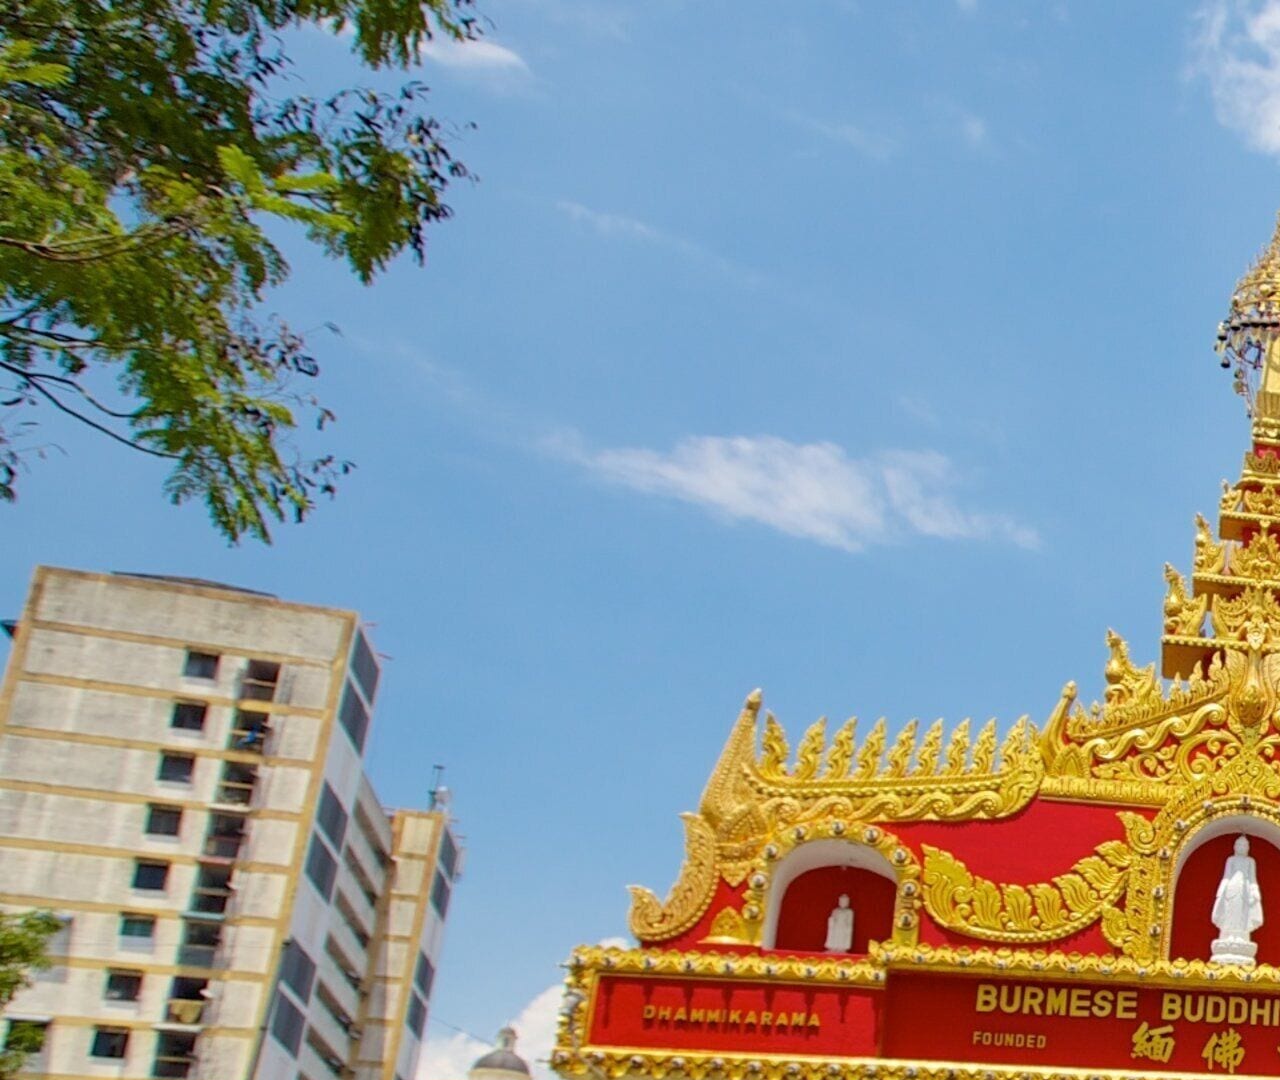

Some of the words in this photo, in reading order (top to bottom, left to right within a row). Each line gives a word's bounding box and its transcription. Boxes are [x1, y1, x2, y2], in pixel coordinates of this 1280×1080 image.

[975, 984, 1138, 1019] BURMESE
[642, 1005, 821, 1027] DHAMMIKARAMA
[972, 1031, 1047, 1049] FOUNDED
